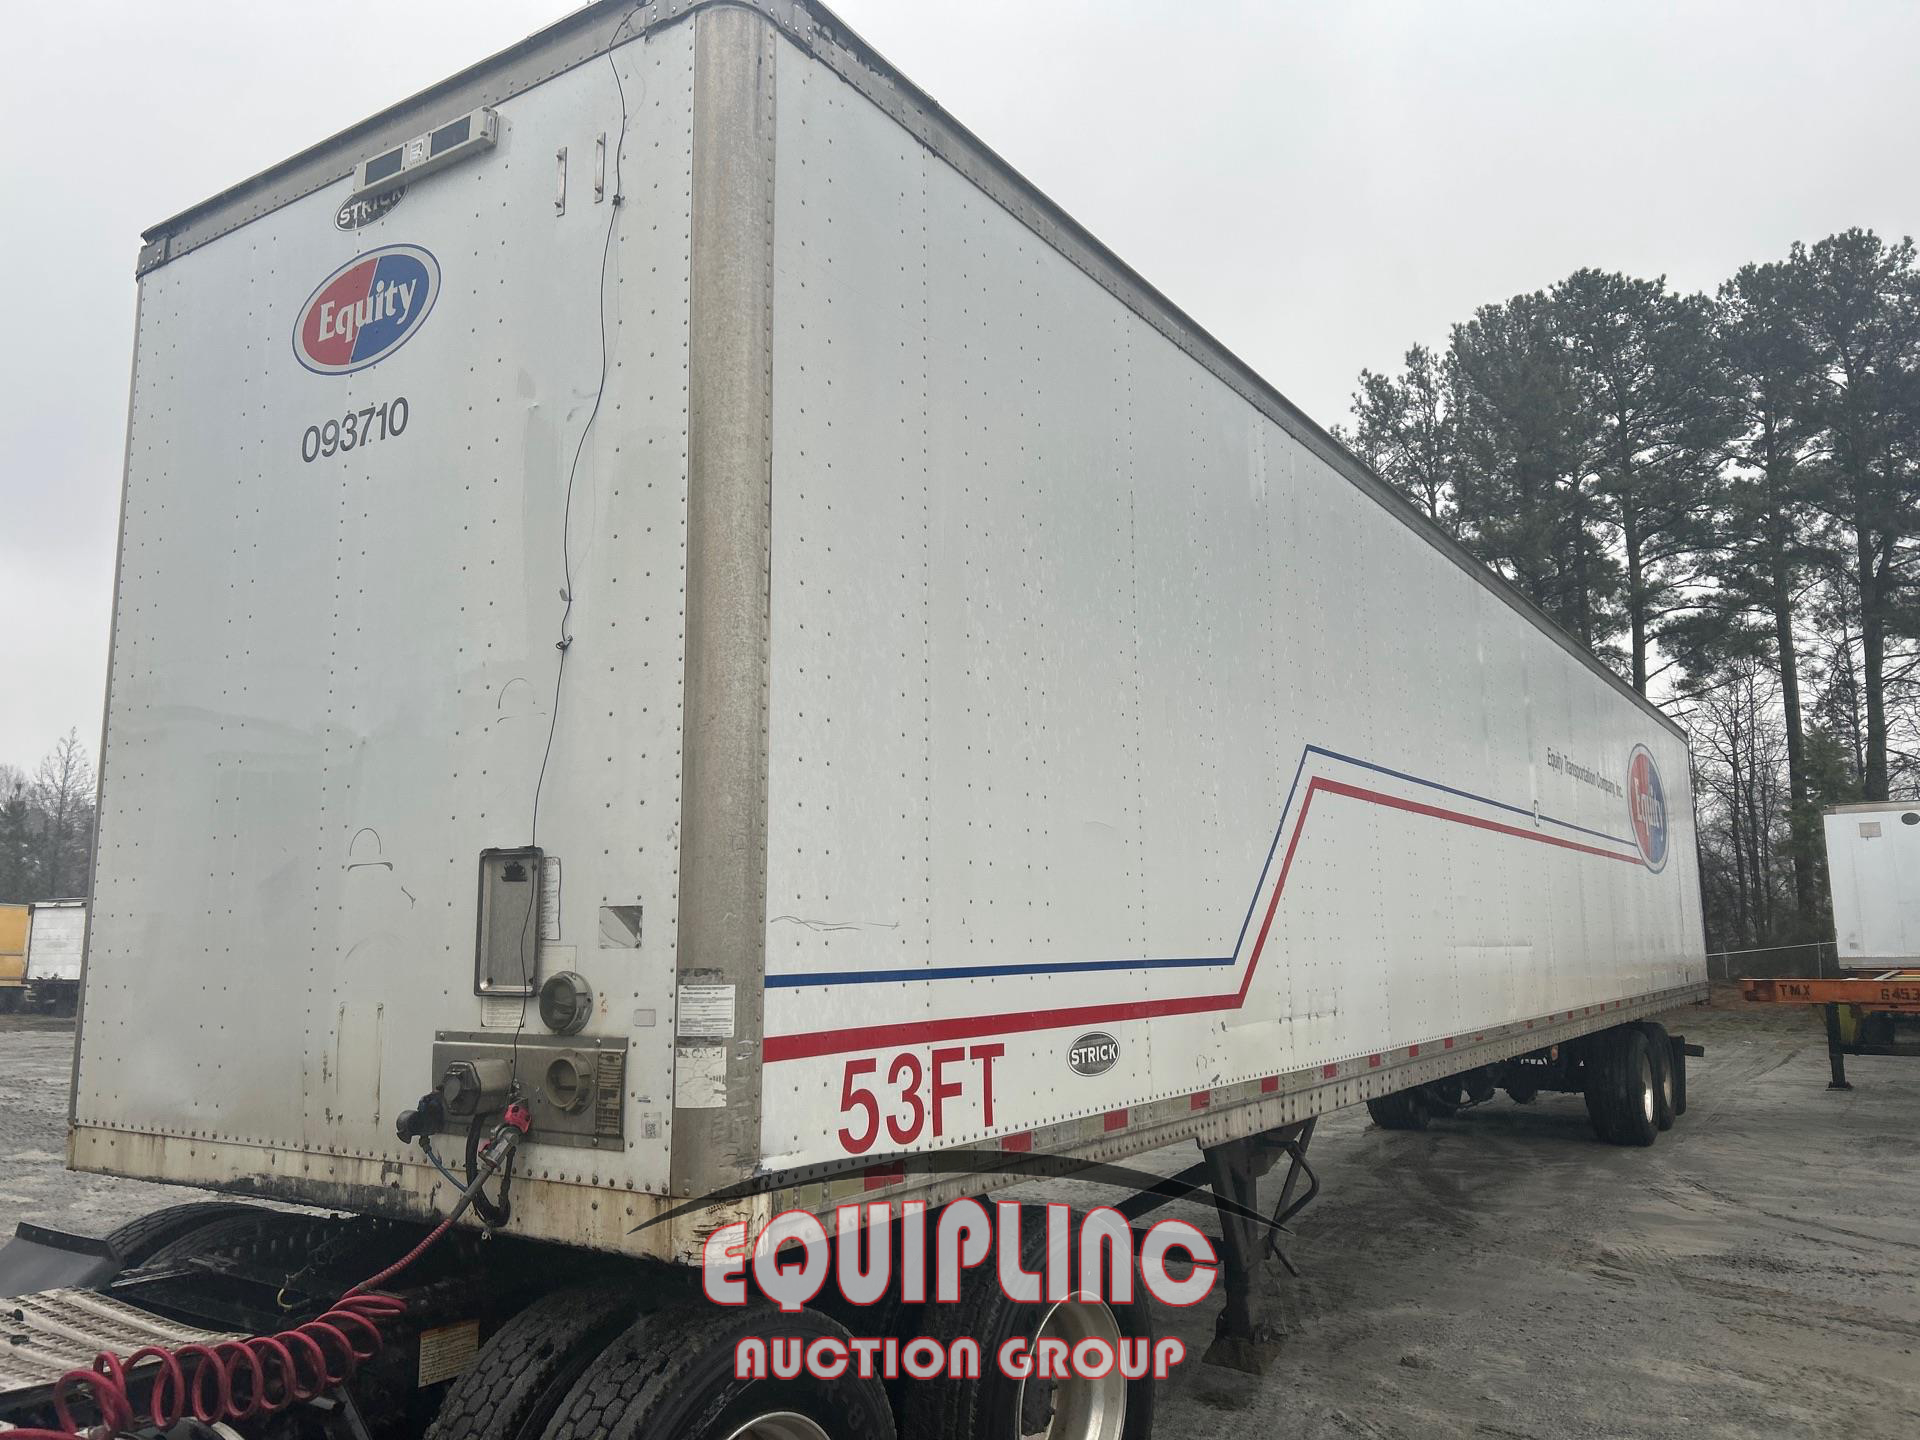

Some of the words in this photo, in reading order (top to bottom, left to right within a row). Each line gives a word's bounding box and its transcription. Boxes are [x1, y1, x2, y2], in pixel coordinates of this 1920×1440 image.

[317, 278, 418, 343] Equity
[301, 396, 409, 463] 093710
[1779, 984, 1810, 996] TMX
[1070, 1042, 1117, 1066] STRICK
[838, 1043, 1005, 1154] 53FT
